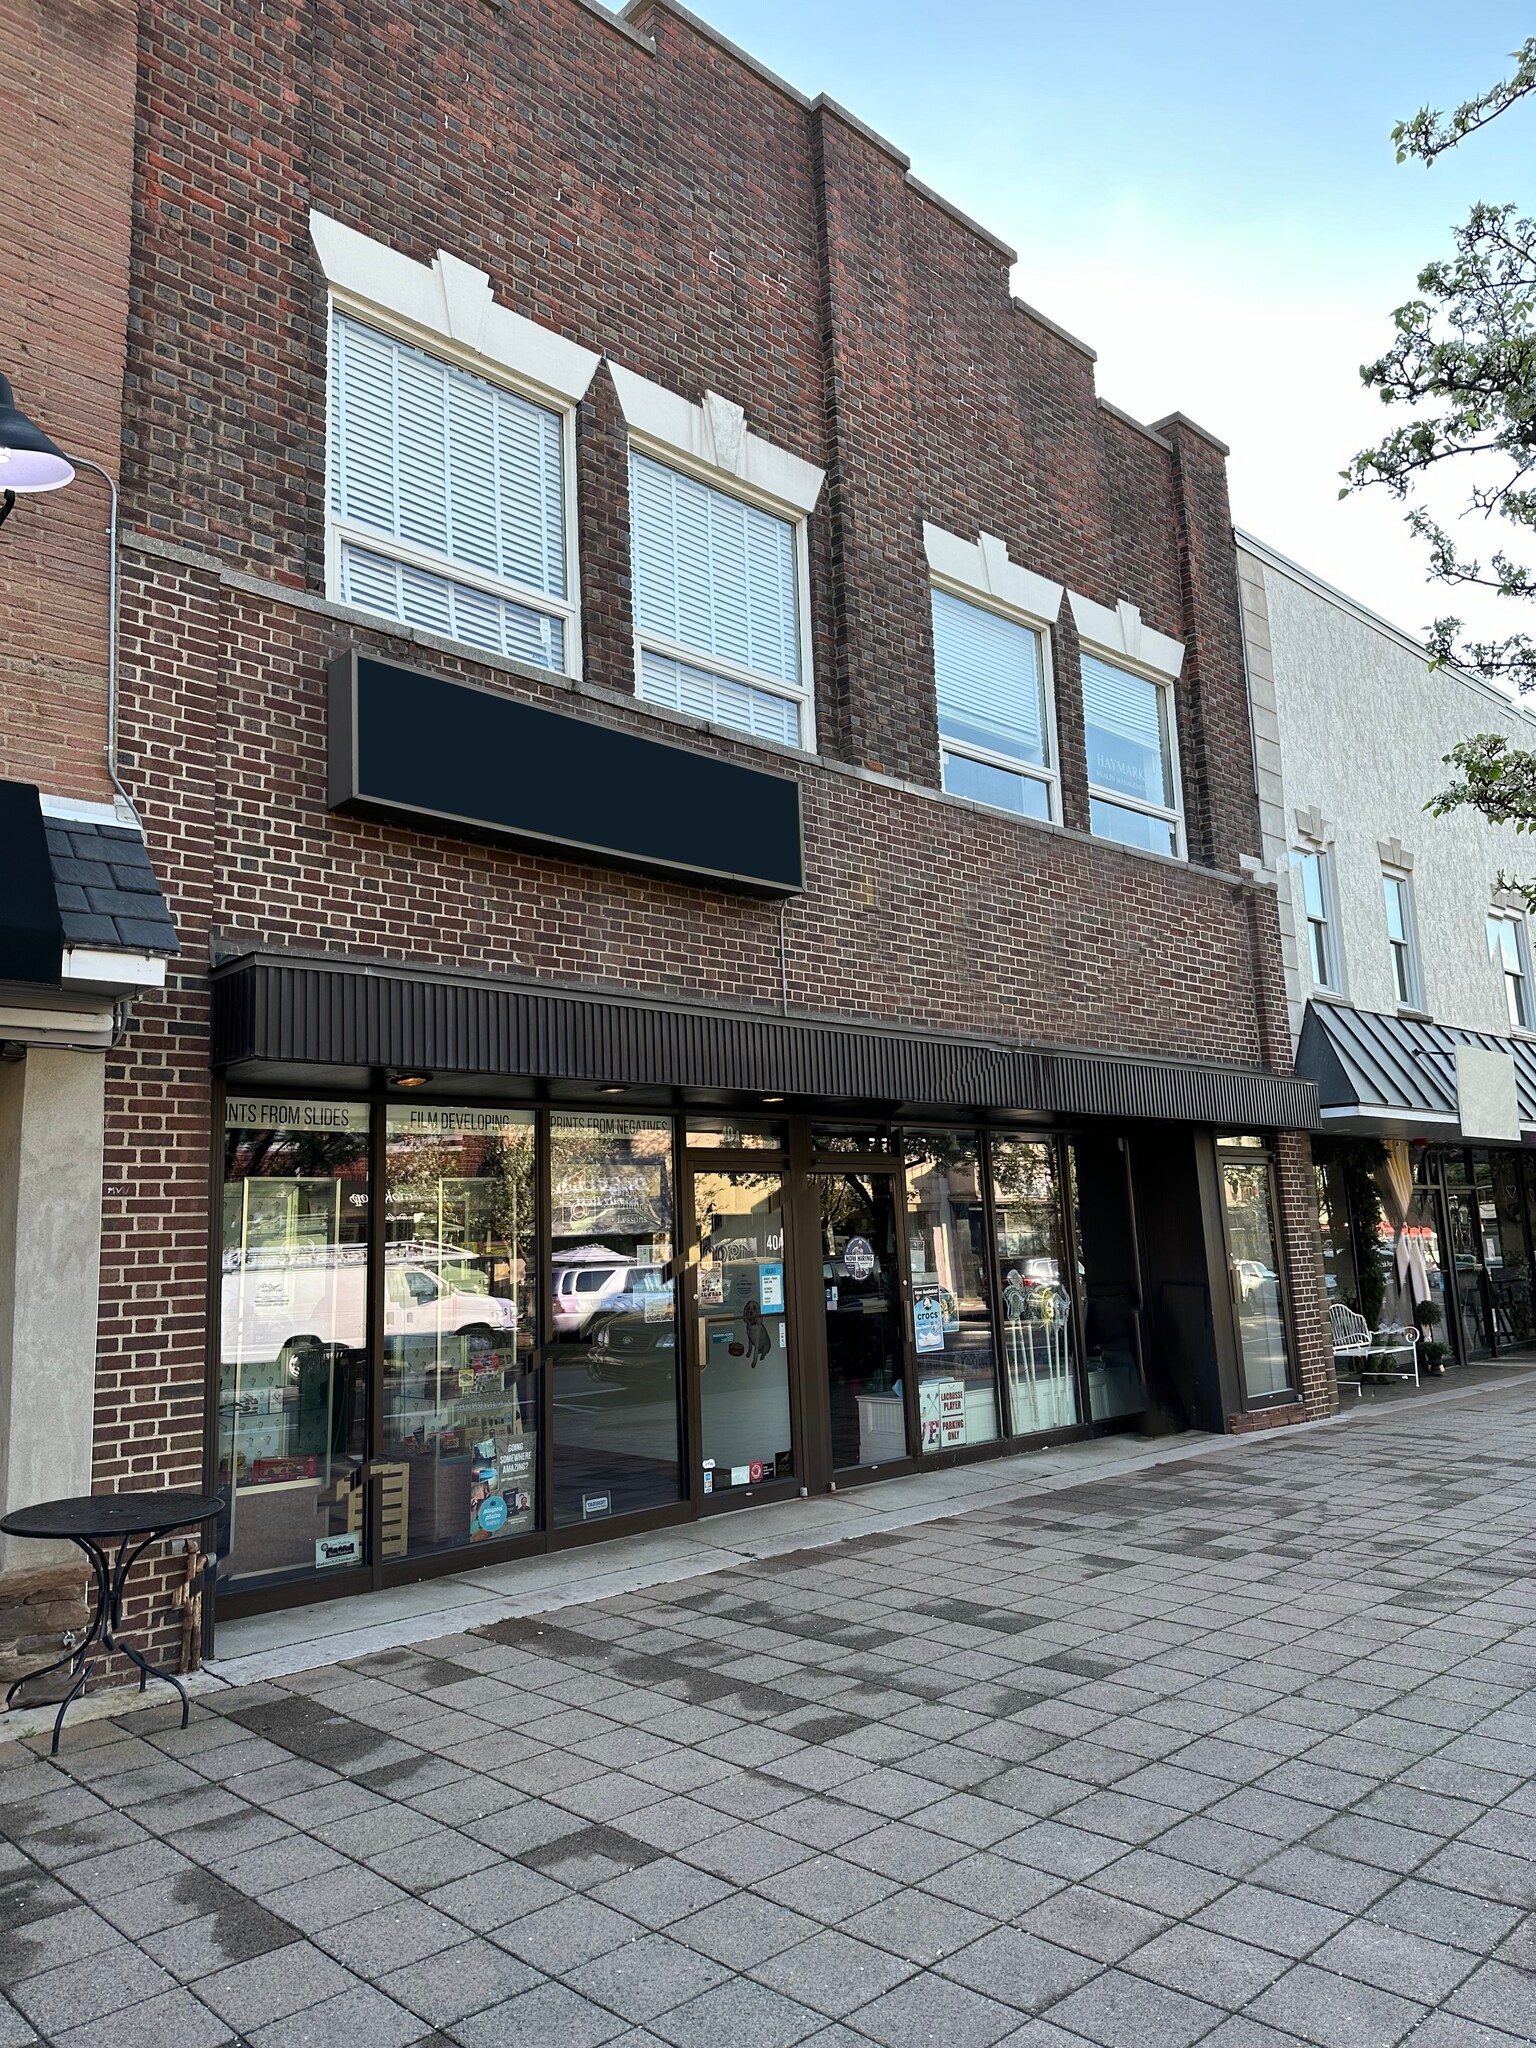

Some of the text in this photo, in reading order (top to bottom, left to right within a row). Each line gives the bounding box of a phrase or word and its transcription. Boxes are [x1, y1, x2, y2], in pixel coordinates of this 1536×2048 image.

[1096, 753, 1145, 781] HAYMARK
[260, 1105, 300, 1124] FROM
[304, 1107, 349, 1126] SLIDES
[410, 1111, 509, 1131] FILM DEVELOPING
[550, 1115, 668, 1135] PRINTS FROM NEGATIVES
[617, 1214, 648, 1224] Lessons
[917, 1311, 938, 1321] crocs
[941, 1391, 963, 1401] LACROSSE
[944, 1401, 961, 1411] PLAYER
[943, 1419, 964, 1431] PARKING
[948, 1431, 959, 1441] ONLY
[508, 1443, 524, 1453] GOING
[500, 1451, 532, 1464] SOMEWHERE
[502, 1462, 528, 1474] AMAZING?
[778, 1464, 790, 1473] PRO
